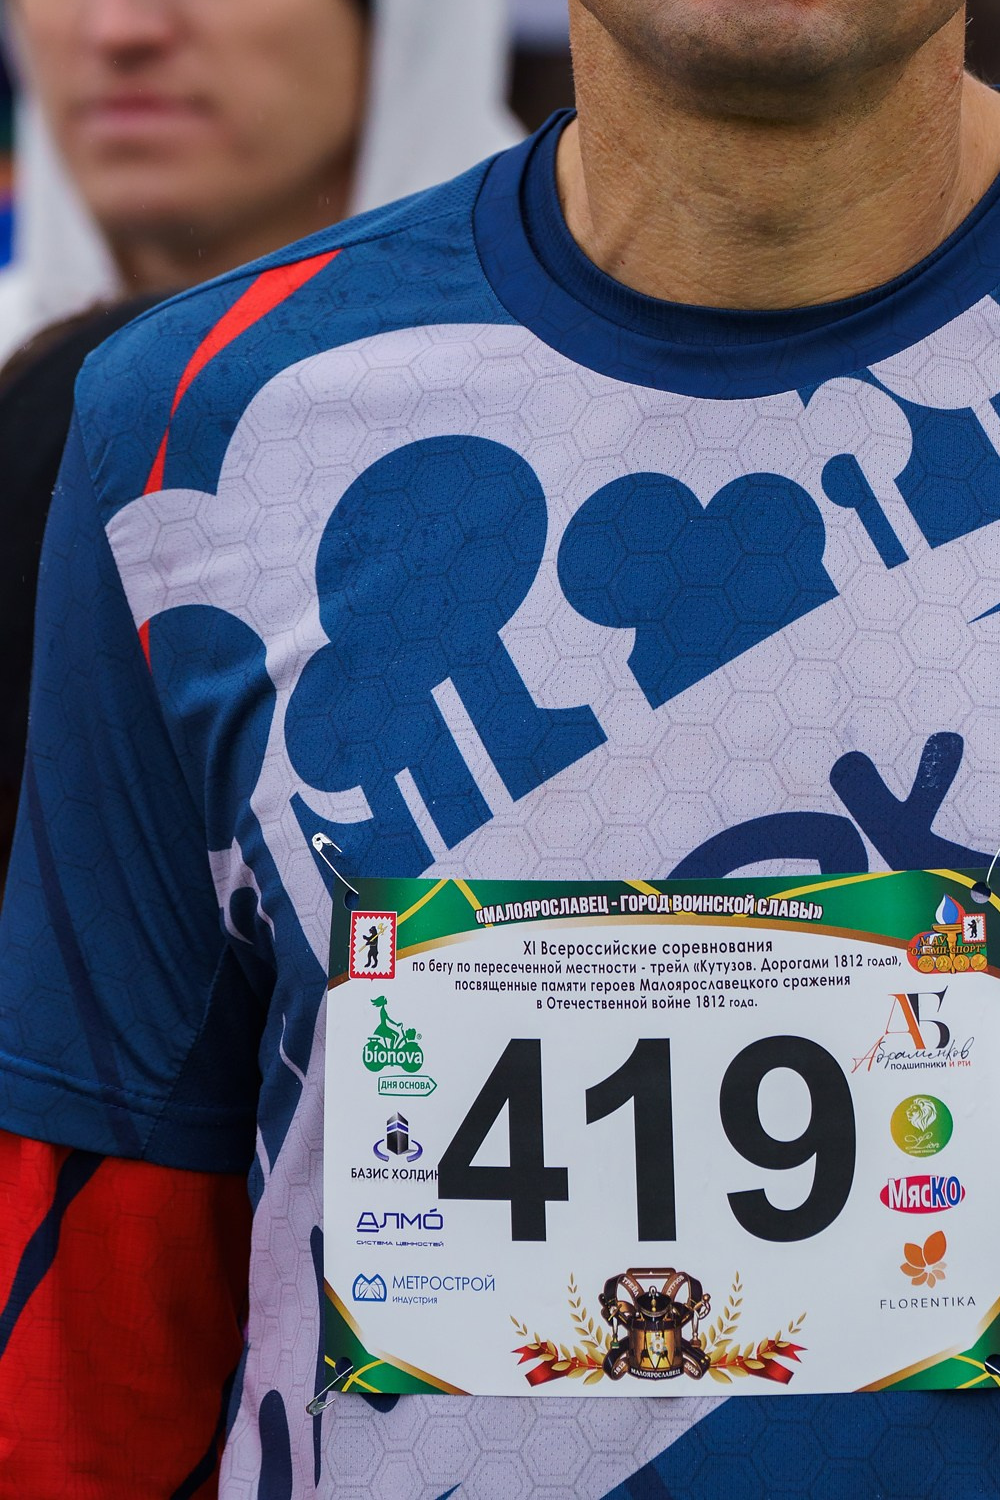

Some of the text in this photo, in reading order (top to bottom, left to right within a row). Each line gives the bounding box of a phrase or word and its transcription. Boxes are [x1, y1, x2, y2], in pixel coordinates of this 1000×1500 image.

[475, 895, 609, 924] «МАЛОЯРОСЛАВЕЦ
[620, 894, 669, 913] ГОРОД
[672, 893, 755, 916] ВОИНСКОЙ
[757, 896, 823, 920] СЛАВЫ»
[541, 939, 656, 958] Всероссийские
[662, 941, 773, 957] соревнования
[412, 961, 425, 972] по
[429, 959, 454, 975] бегу
[457, 962, 470, 973] по
[474, 960, 562, 976] пересеченной
[566, 964, 637, 974] местности
[650, 960, 689, 976] трейл
[693, 959, 756, 975] «Кутузов.
[761, 957, 829, 974] Дорогами
[834, 954, 863, 968] 1812
[867, 955, 902, 968] года»,
[455, 975, 850, 994] посвященные памяти героев Малоярославецкого сражения
[536, 995, 758, 1010] в Отечественной войне 1812 года.
[364, 1046, 422, 1064] bionova
[851, 1037, 975, 1073] Абраменков
[380, 1080, 431, 1090] ДНЯ ОСНОВА
[438, 1035, 857, 1242] 419
[351, 1167, 438, 1182] БАЗИС ХОЛДИН
[888, 1176, 961, 1208] МясКО
[392, 1274, 495, 1292] МЕТРОСТРОЙ
[392, 1296, 438, 1305] индустрия
[880, 1296, 976, 1309] FLORENTIKA
